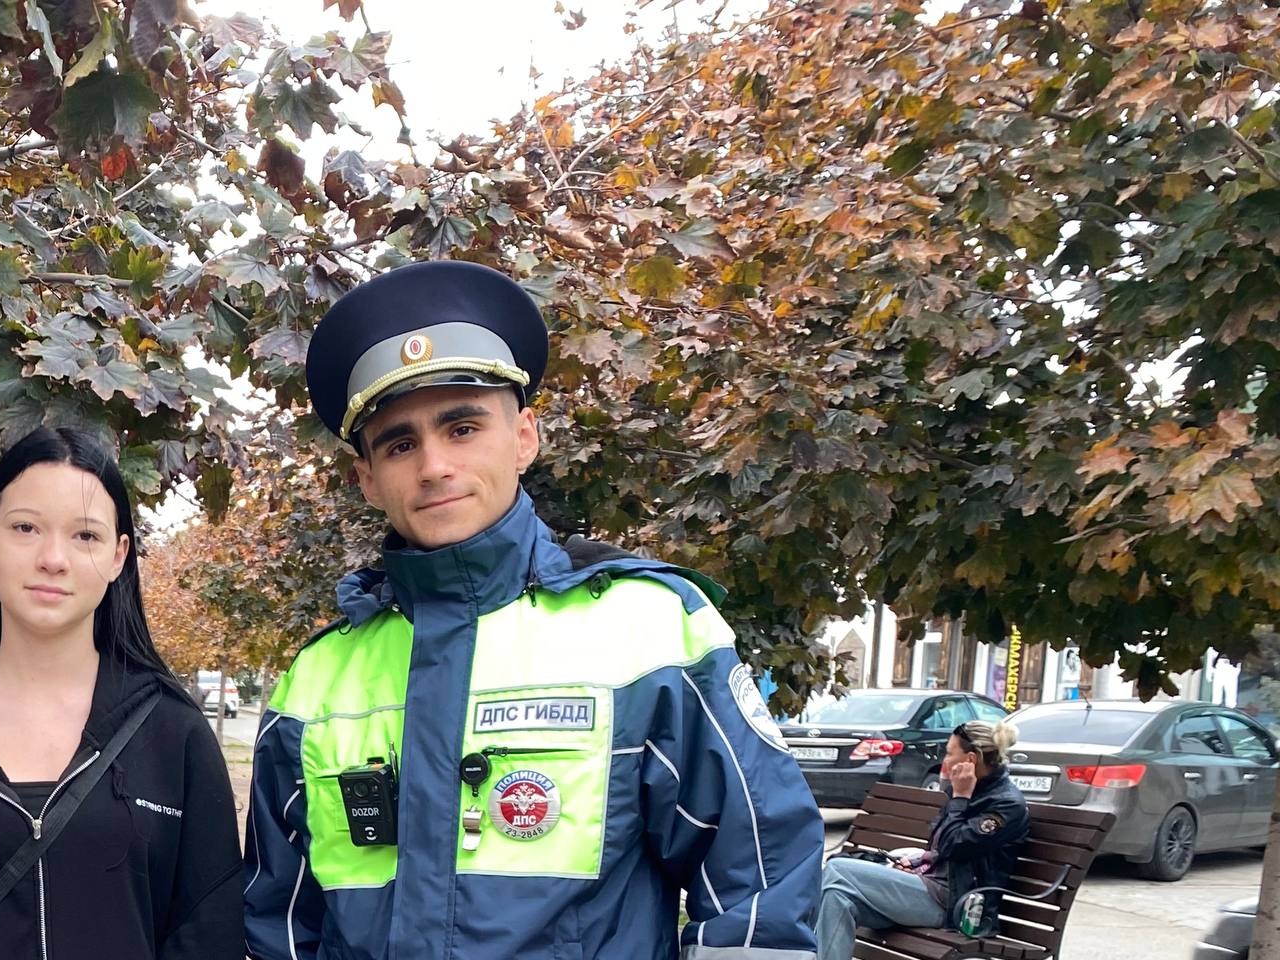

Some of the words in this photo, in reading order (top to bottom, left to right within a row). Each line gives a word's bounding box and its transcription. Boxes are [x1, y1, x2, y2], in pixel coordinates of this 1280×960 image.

[480, 706, 519, 726] ДПС
[524, 704, 588, 723] ГИБДД
[496, 771, 552, 791] ПОЛИЦИЯ
[351, 807, 380, 817] DOZOR
[512, 815, 537, 826] ДПС
[505, 826, 544, 839] 23-2848
